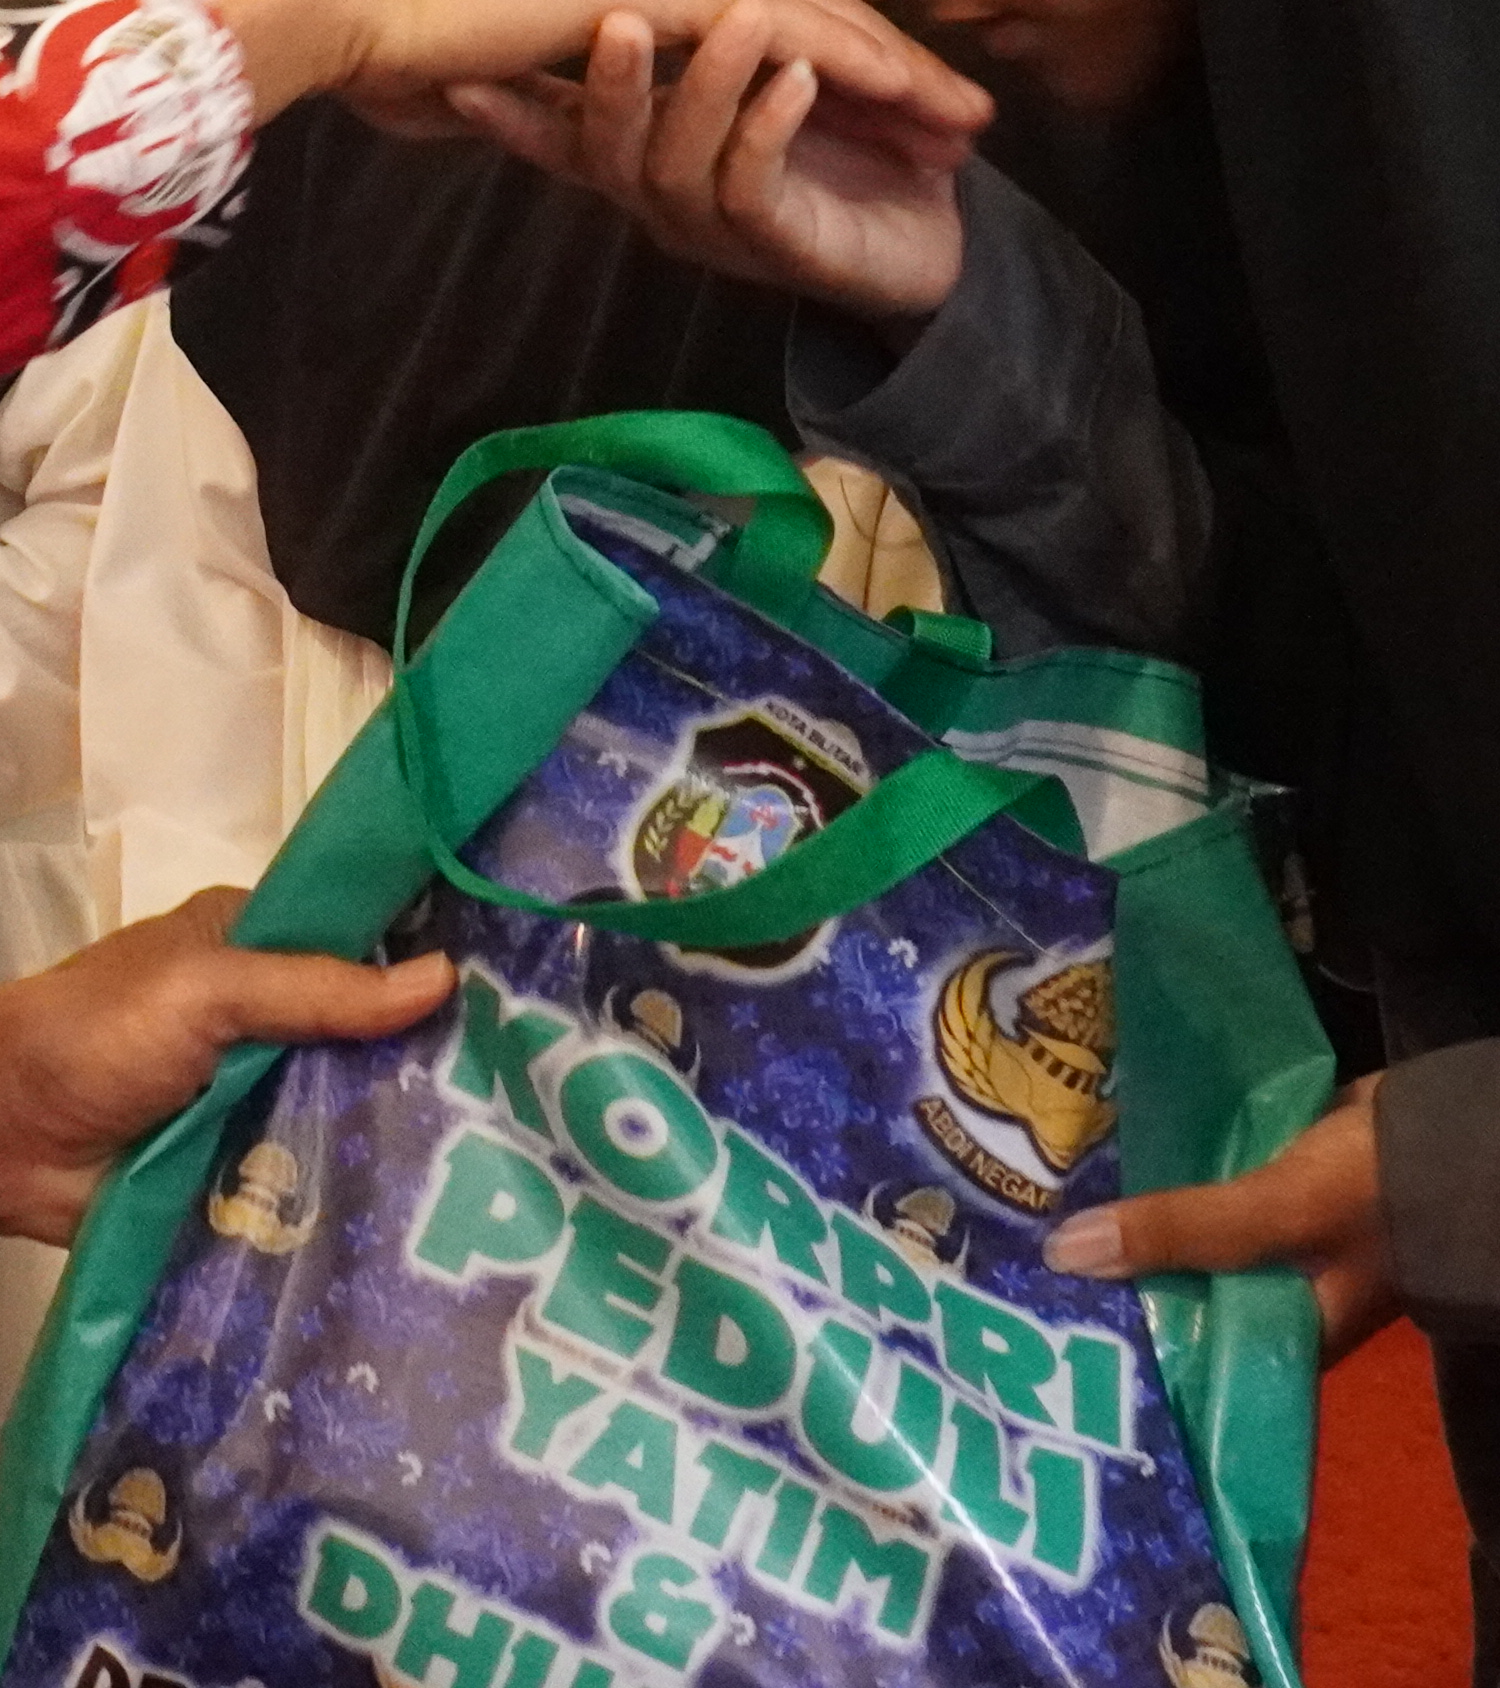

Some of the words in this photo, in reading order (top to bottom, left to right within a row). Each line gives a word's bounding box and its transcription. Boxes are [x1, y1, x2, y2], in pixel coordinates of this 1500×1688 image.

[447, 965, 1124, 1434] KORPRI
[919, 1098, 974, 1159] ABDI
[411, 1127, 1086, 1579] PEDULI
[507, 1342, 938, 1642] YATIM
[607, 1550, 720, 1673] &
